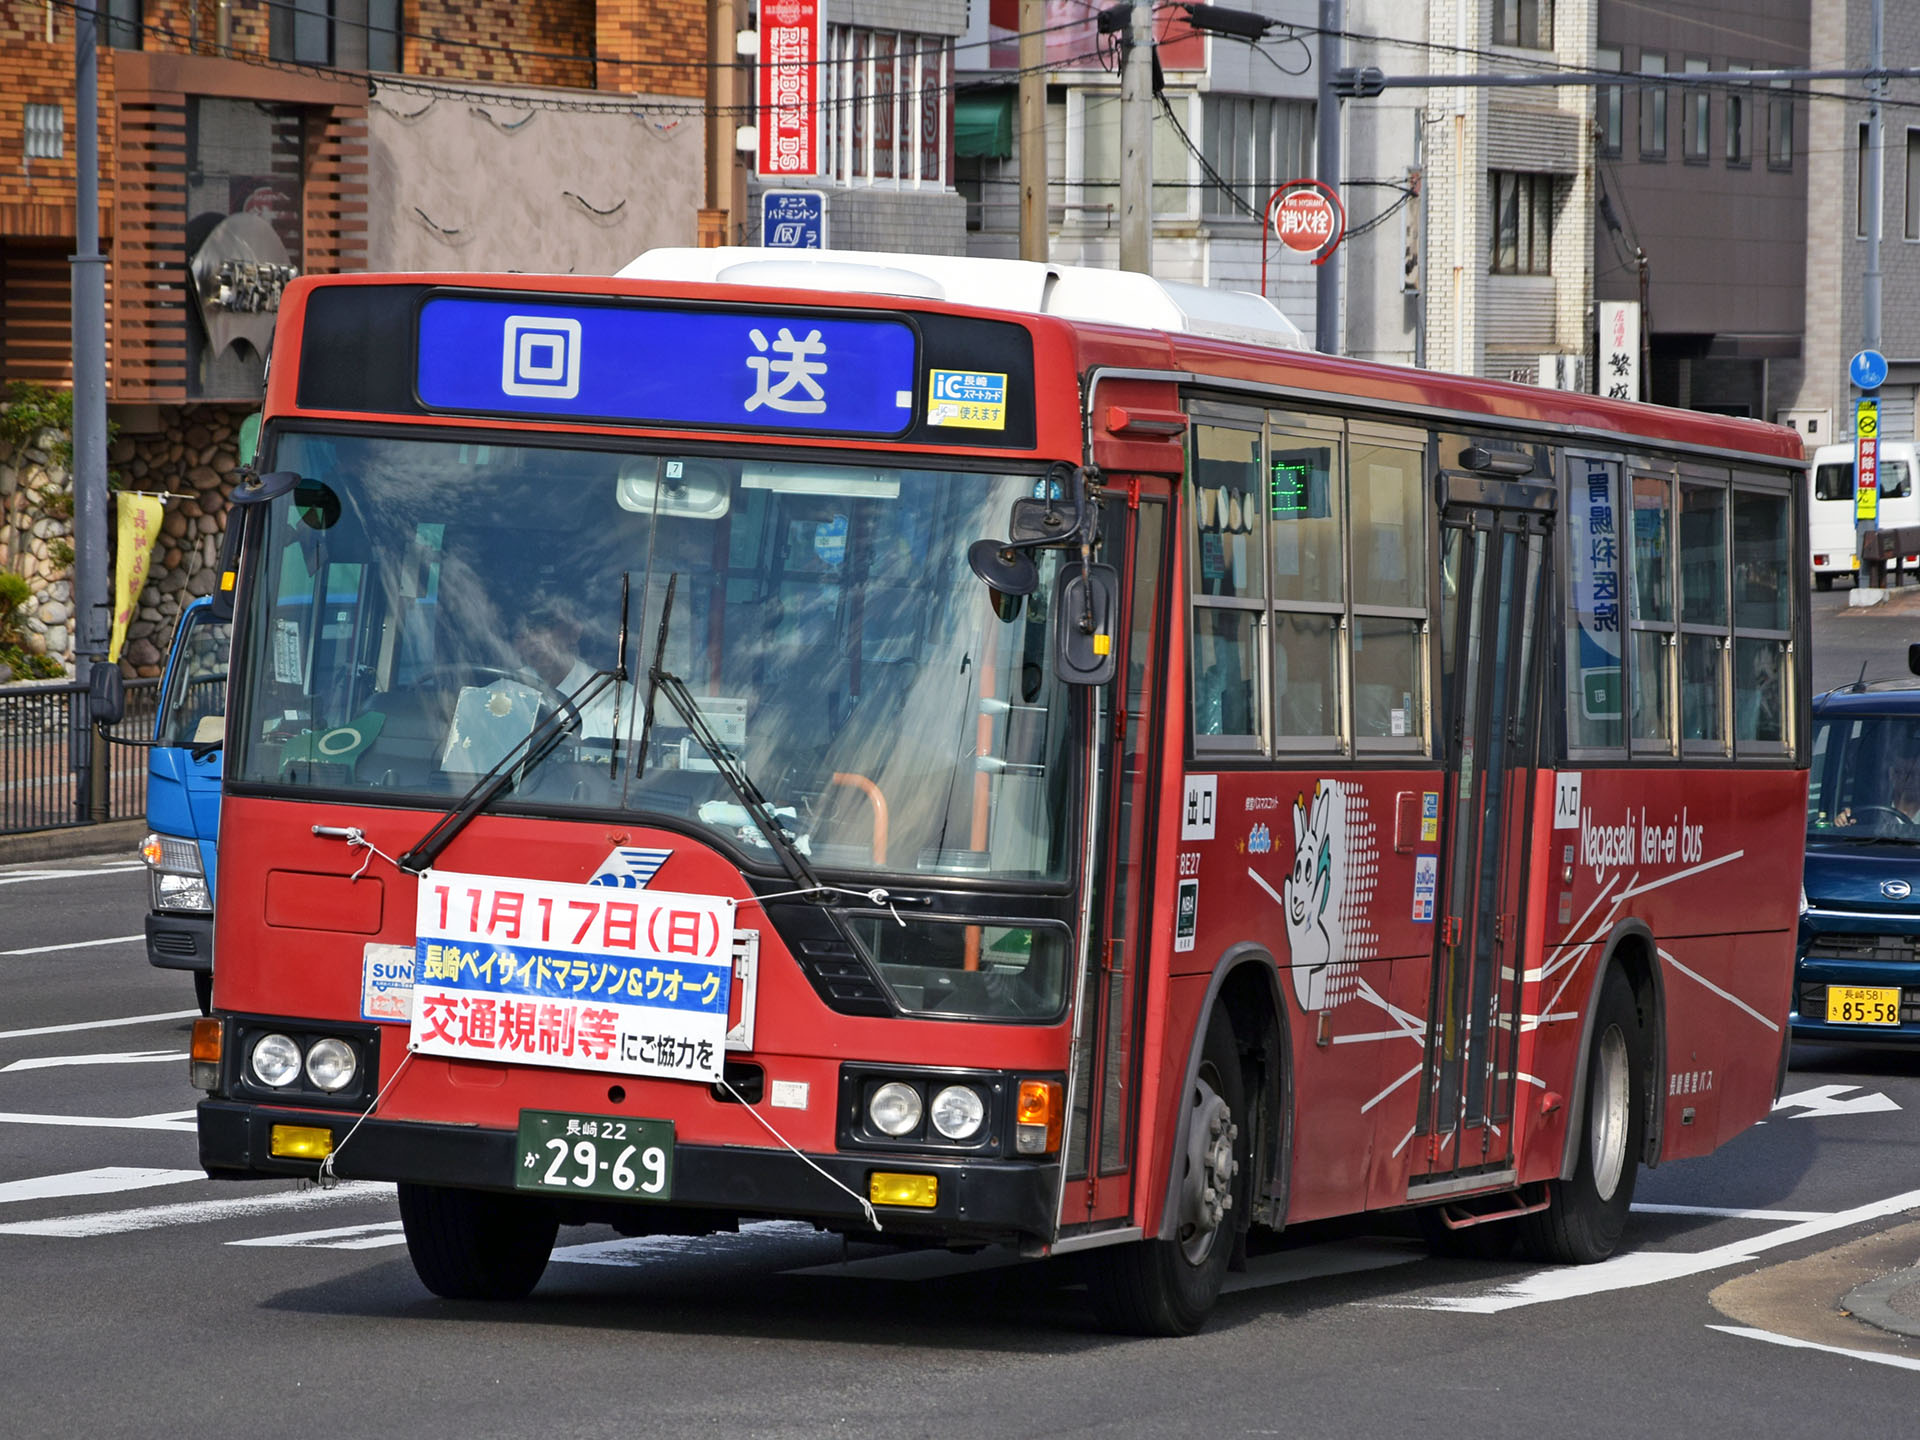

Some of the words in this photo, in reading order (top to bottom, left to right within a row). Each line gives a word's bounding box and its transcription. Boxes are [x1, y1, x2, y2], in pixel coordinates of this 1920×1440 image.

[779, 27, 800, 129] RIBBON
[779, 137, 800, 170] DS
[768, 209, 818, 219] バドミントン
[779, 197, 807, 208] テニス
[1281, 209, 1329, 234] 消火栓
[963, 375, 988, 387] 長崎
[963, 389, 1002, 401] スマートカード
[960, 406, 1001, 421] 使えます
[1860, 441, 1875, 485] 解除中
[1187, 789, 1212, 825] 出口
[1559, 785, 1578, 817] 入口
[1580, 806, 1636, 885] Nagasaki
[1682, 805, 1704, 863] bus
[1179, 852, 1201, 875] 8E27
[1181, 895, 1194, 912] NBA
[435, 884, 720, 957] 11月17日(日)
[1842, 1002, 1896, 1023] 85-58
[523, 1151, 541, 1169] か
[543, 1138, 666, 1194] 29-69
